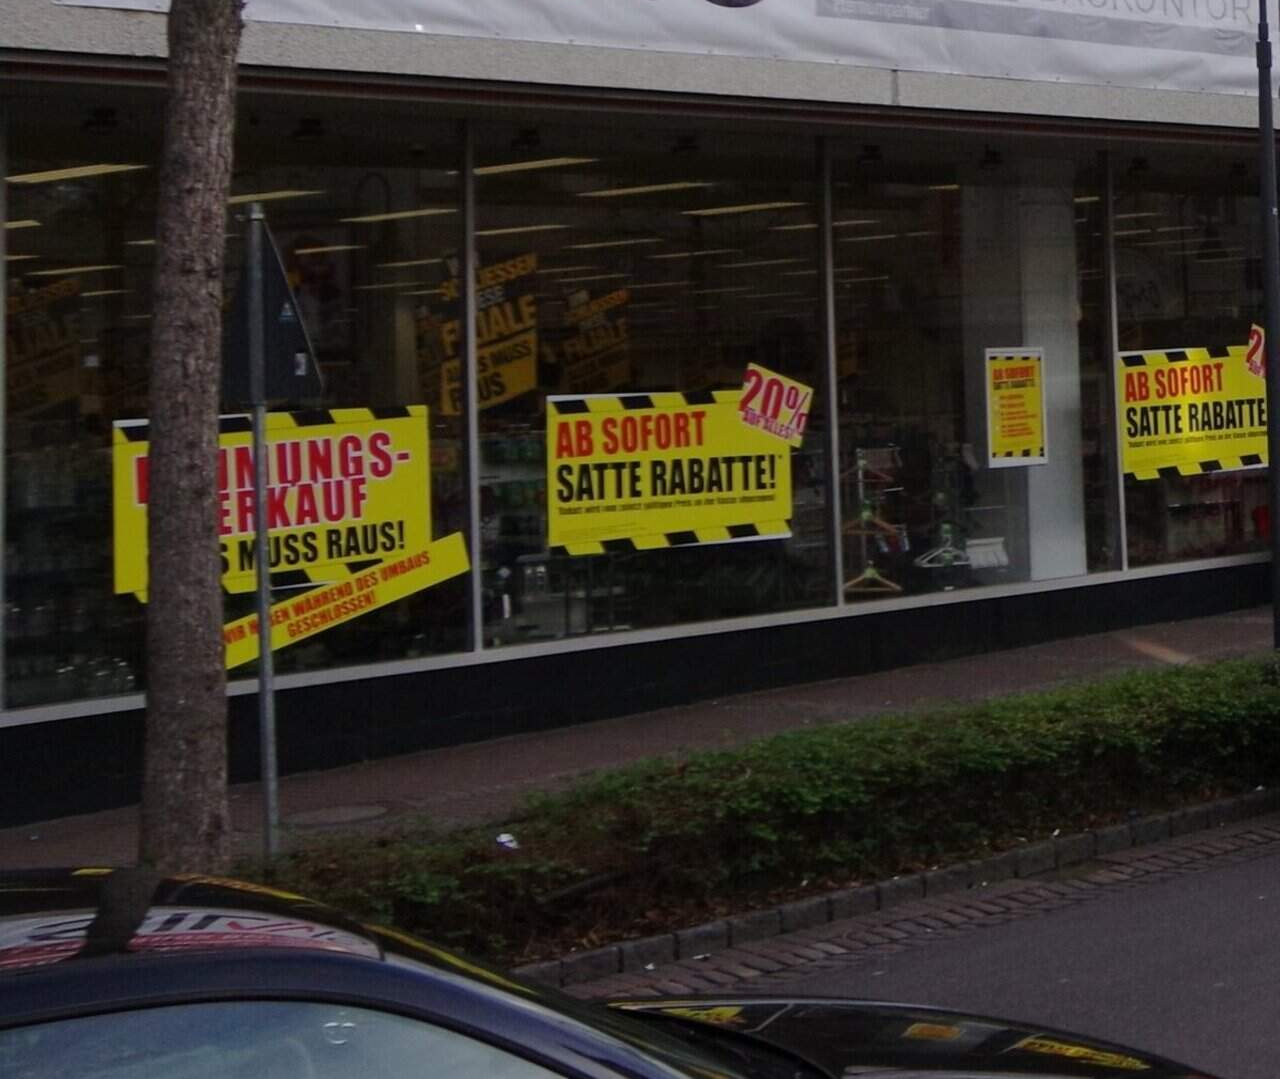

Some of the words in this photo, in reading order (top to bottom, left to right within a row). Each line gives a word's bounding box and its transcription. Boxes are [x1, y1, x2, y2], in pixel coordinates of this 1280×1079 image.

[737, 369, 810, 436] 20%
[1125, 371, 1150, 403] AB
[1154, 363, 1224, 400] SOFORT
[556, 420, 594, 459] AB
[602, 411, 706, 456] SOFORT
[1126, 404, 1183, 439] SATTE
[557, 462, 643, 503] SATTE
[650, 454, 777, 497] RABATTE!
[217, 477, 369, 536] ERKAUF
[327, 520, 405, 559] RAUS!
